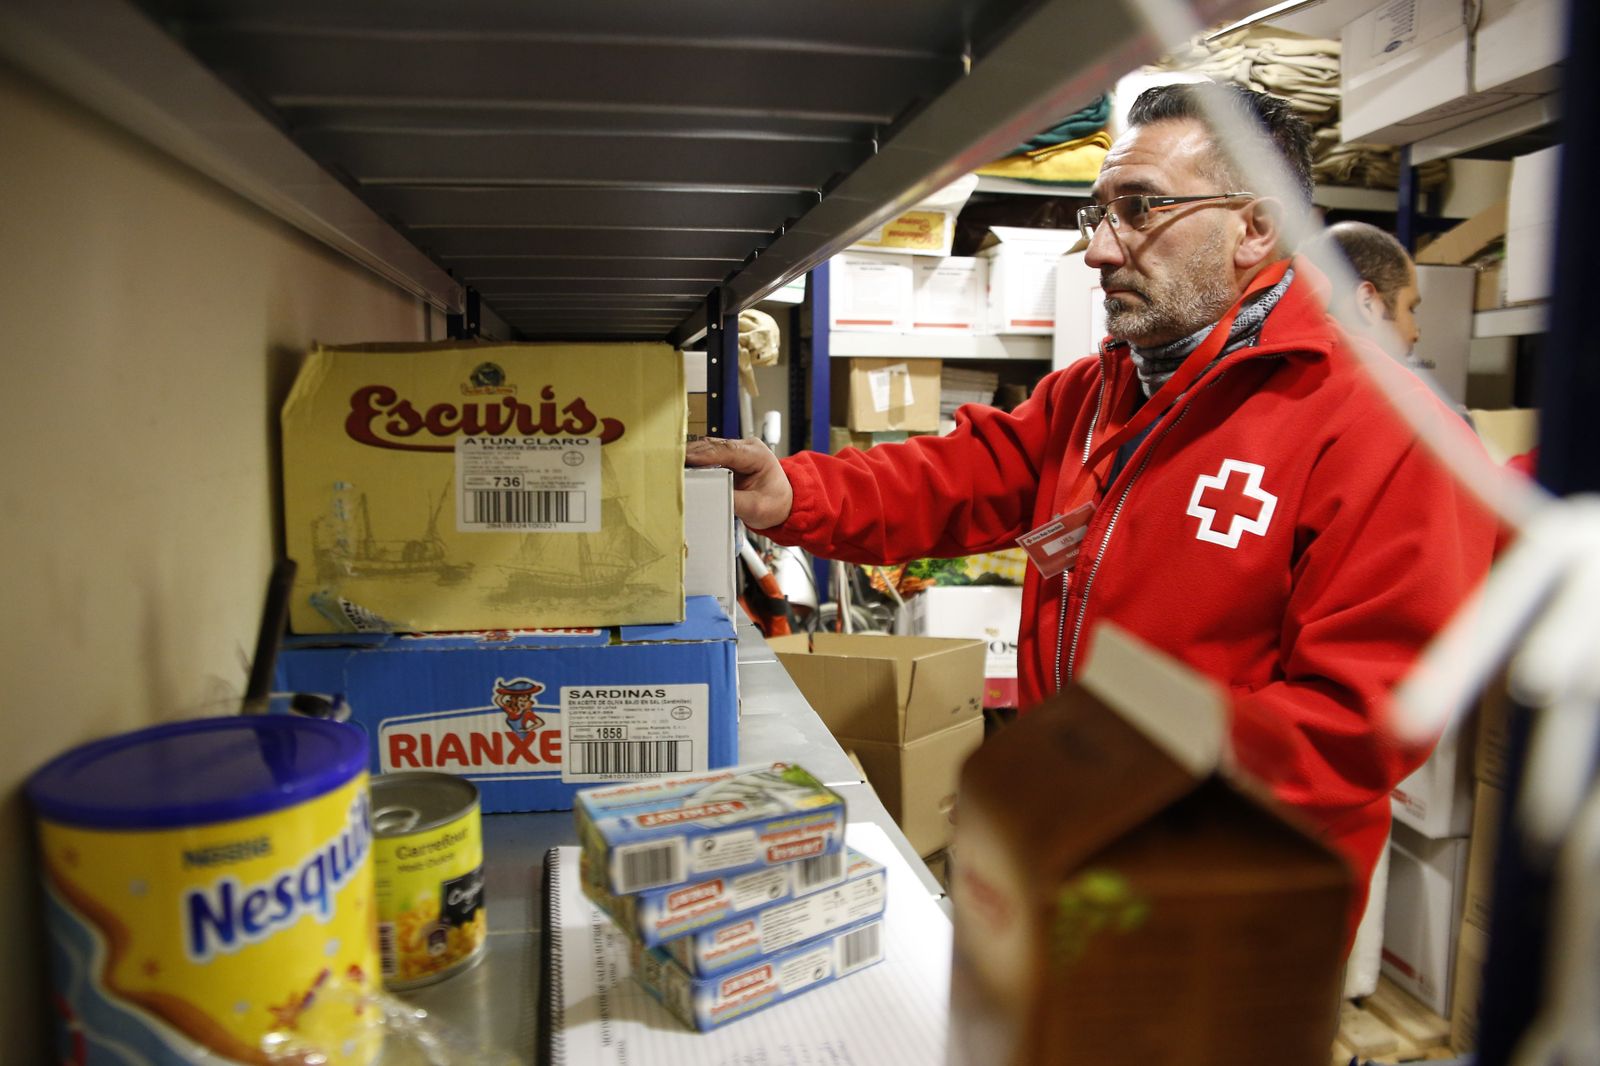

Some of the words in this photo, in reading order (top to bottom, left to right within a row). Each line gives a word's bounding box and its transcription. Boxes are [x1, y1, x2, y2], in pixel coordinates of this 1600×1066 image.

[345, 384, 625, 451] Escuris
[523, 437, 590, 446] CLARO
[493, 476, 521, 488] 736
[569, 689, 666, 699] SARDINAS
[596, 727, 623, 739] 1858
